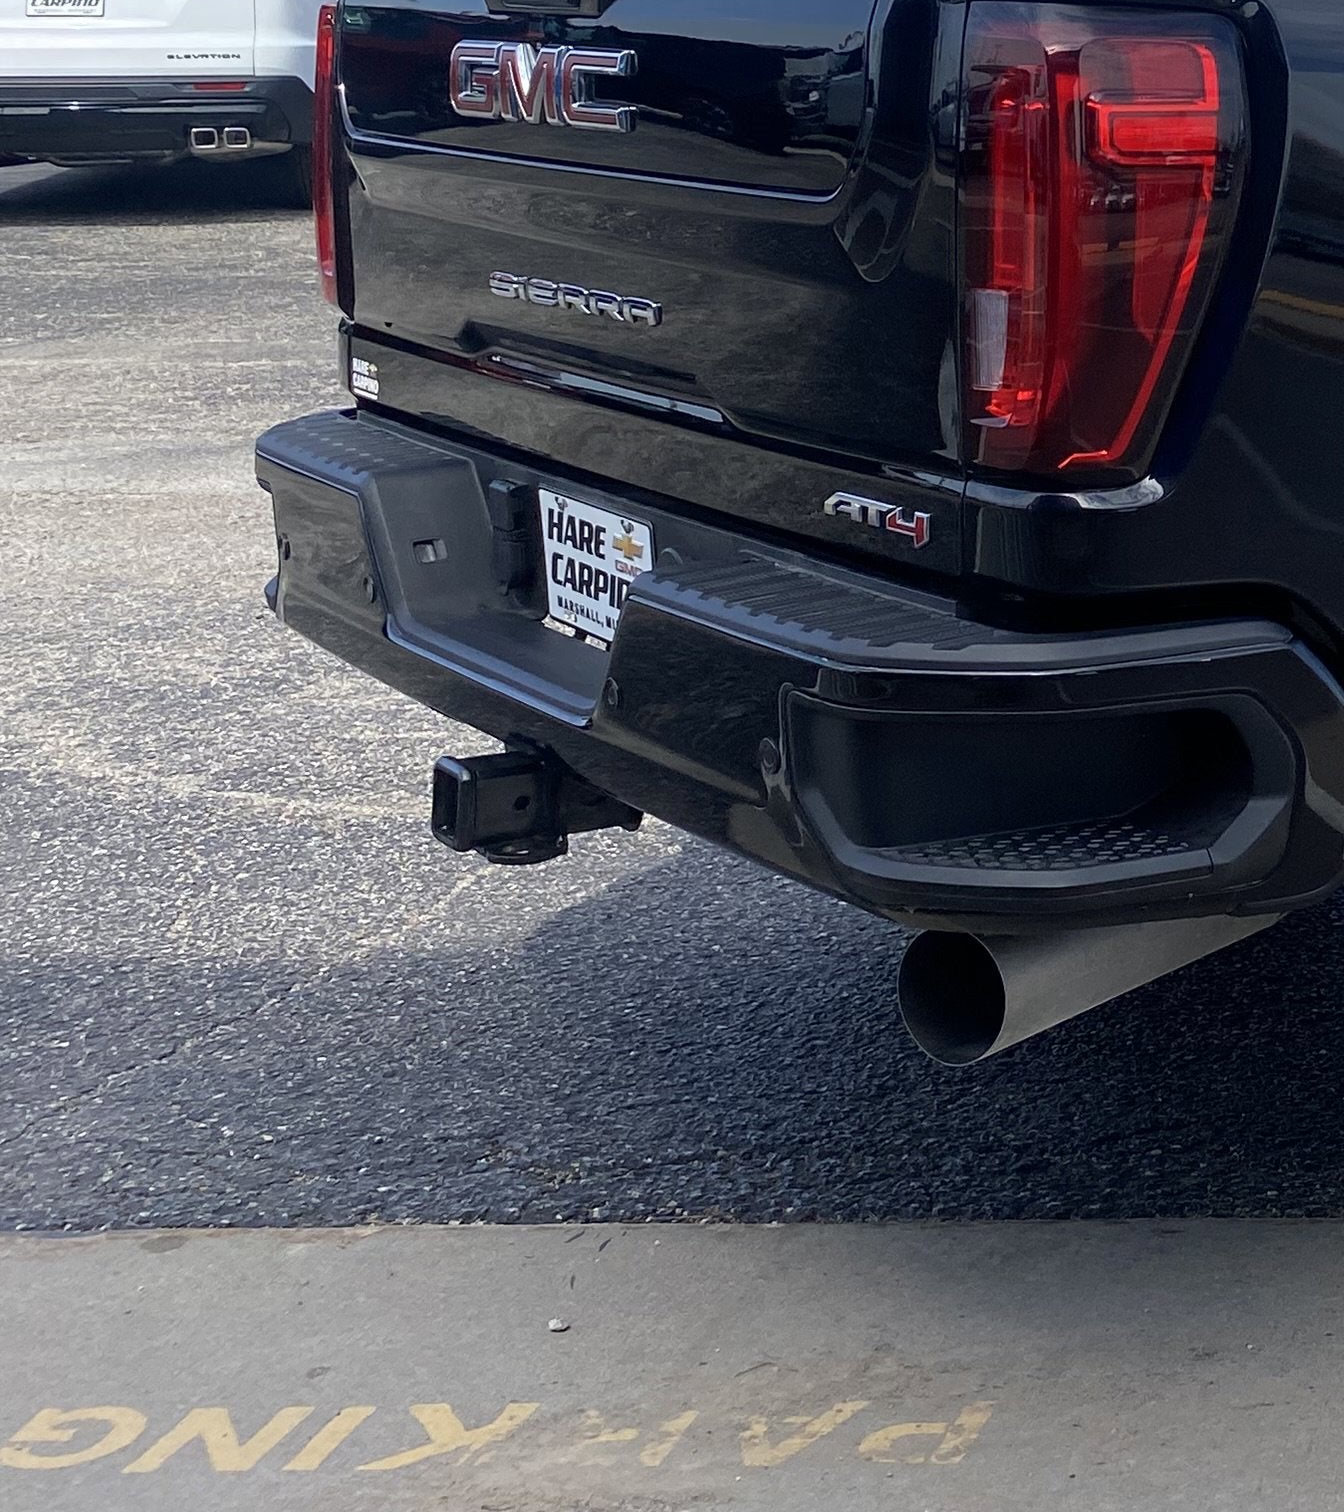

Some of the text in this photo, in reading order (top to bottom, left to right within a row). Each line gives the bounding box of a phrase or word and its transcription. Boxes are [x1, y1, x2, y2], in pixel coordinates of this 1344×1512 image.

[449, 38, 640, 134] GMC
[489, 270, 663, 327] SIERRA
[547, 507, 607, 560] HARE
[823, 491, 932, 548] AT4
[551, 551, 632, 610] CARPIN
[557, 594, 604, 628] MARSHALL,
